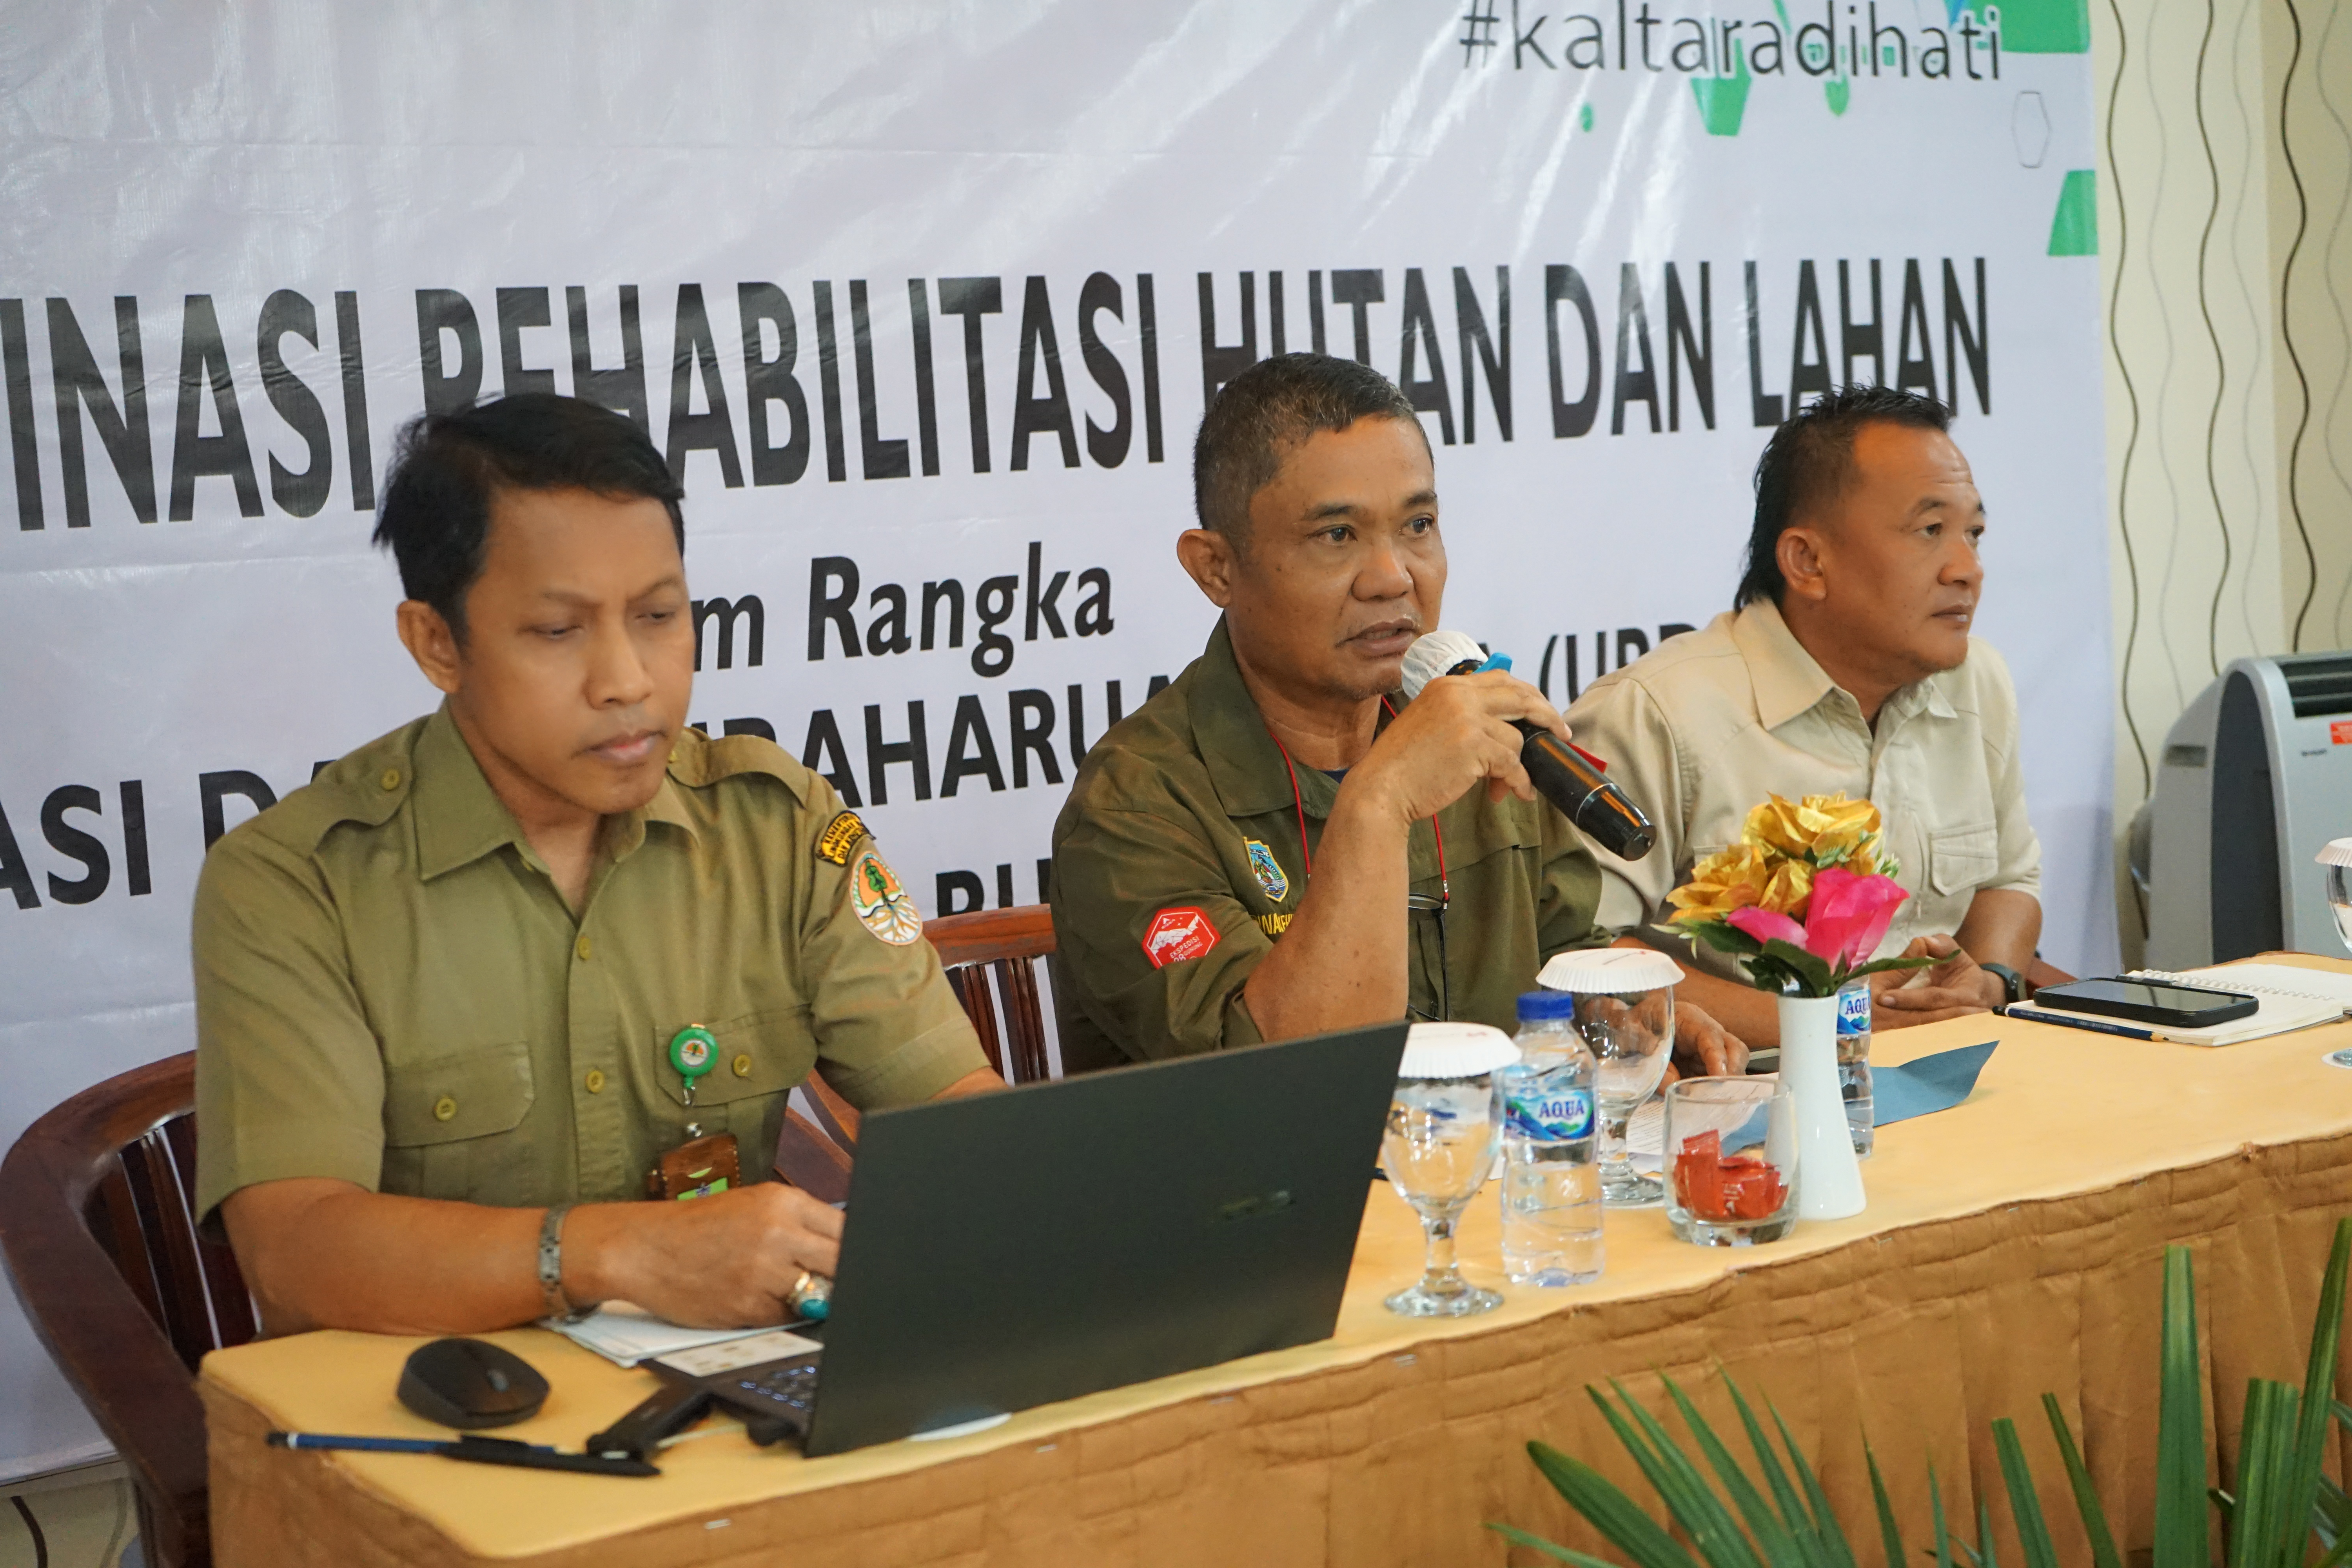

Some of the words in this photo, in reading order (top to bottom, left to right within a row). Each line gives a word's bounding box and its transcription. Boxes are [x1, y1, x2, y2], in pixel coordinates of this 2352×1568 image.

[1459, 0, 2000, 81] #kaltaradihati
[1547, 260, 1715, 439] DAN
[1744, 257, 1990, 427] LAHAN
[808, 541, 1115, 677] Rangka
[1169, 935, 1200, 958] EKSPEDISI
[1539, 1098, 1584, 1120] AQUA
